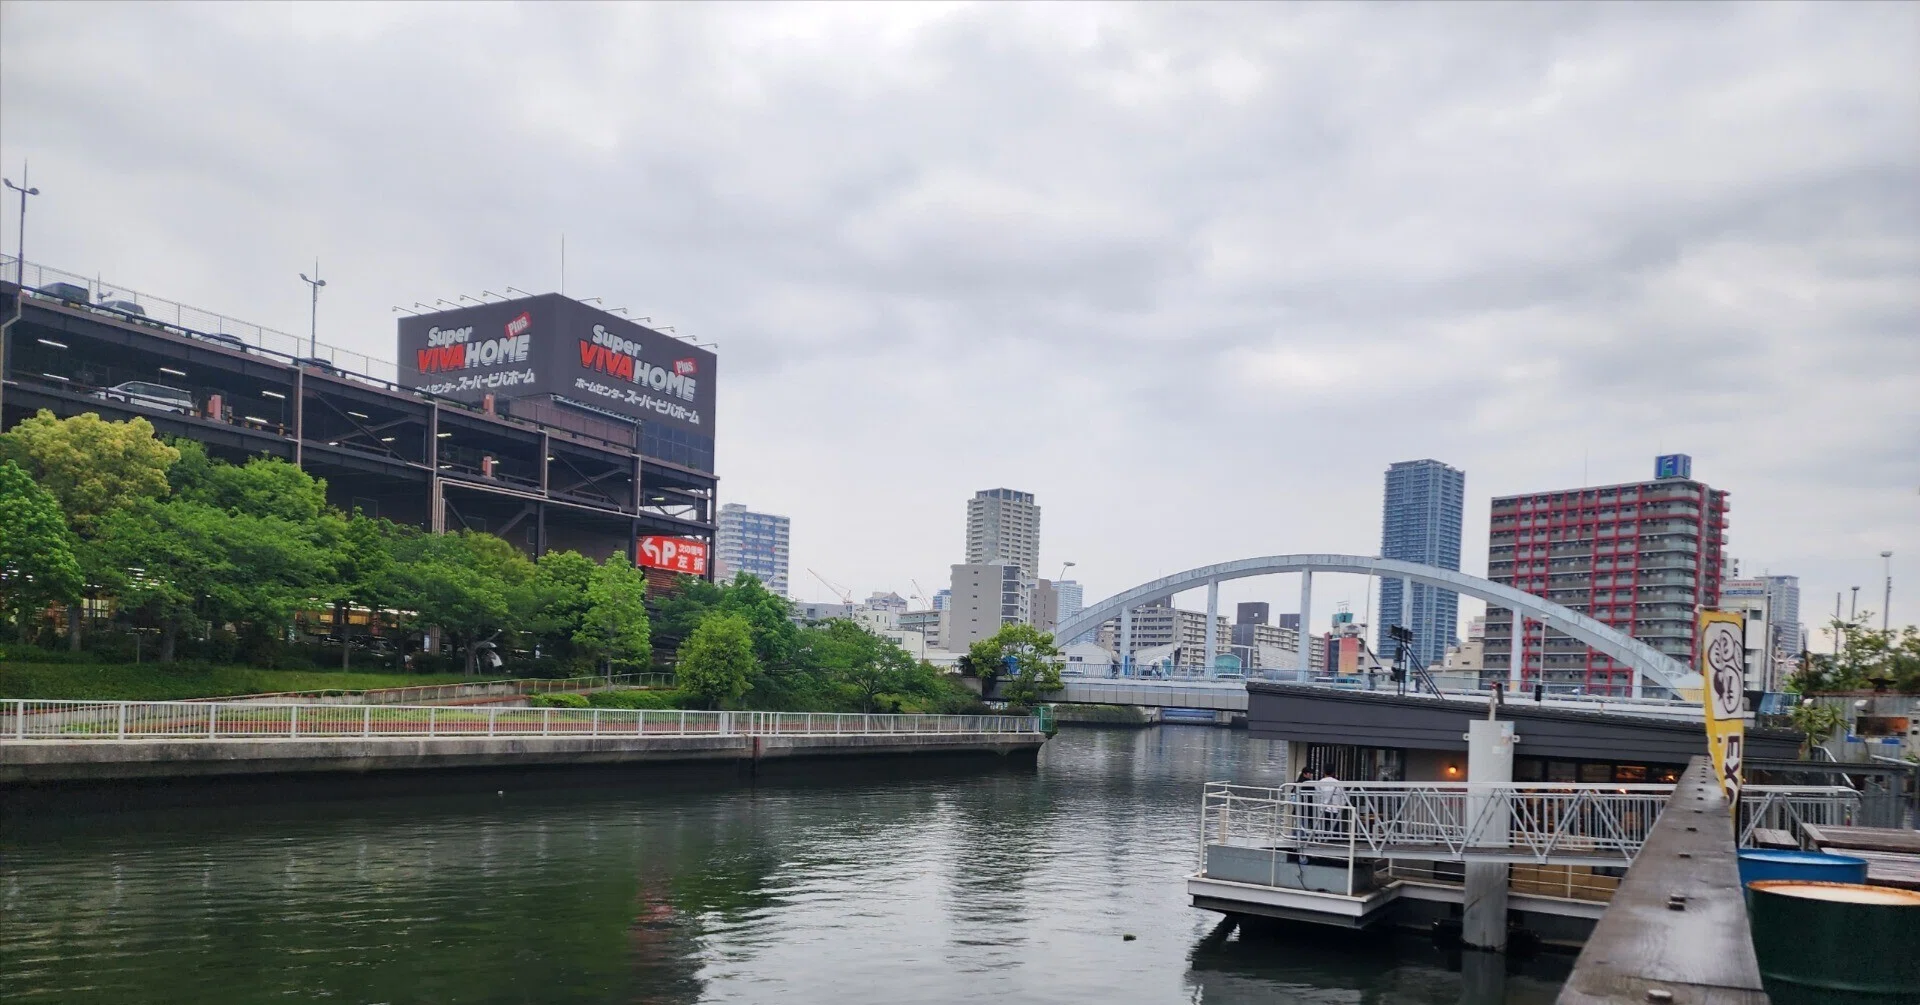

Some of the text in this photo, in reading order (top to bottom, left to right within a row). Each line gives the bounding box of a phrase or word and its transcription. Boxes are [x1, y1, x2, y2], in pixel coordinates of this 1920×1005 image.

[428, 326, 473, 348] Super
[508, 316, 529, 336] Plus
[592, 324, 642, 358] Super
[676, 361, 694, 374] Plus
[662, 540, 677, 566] P
